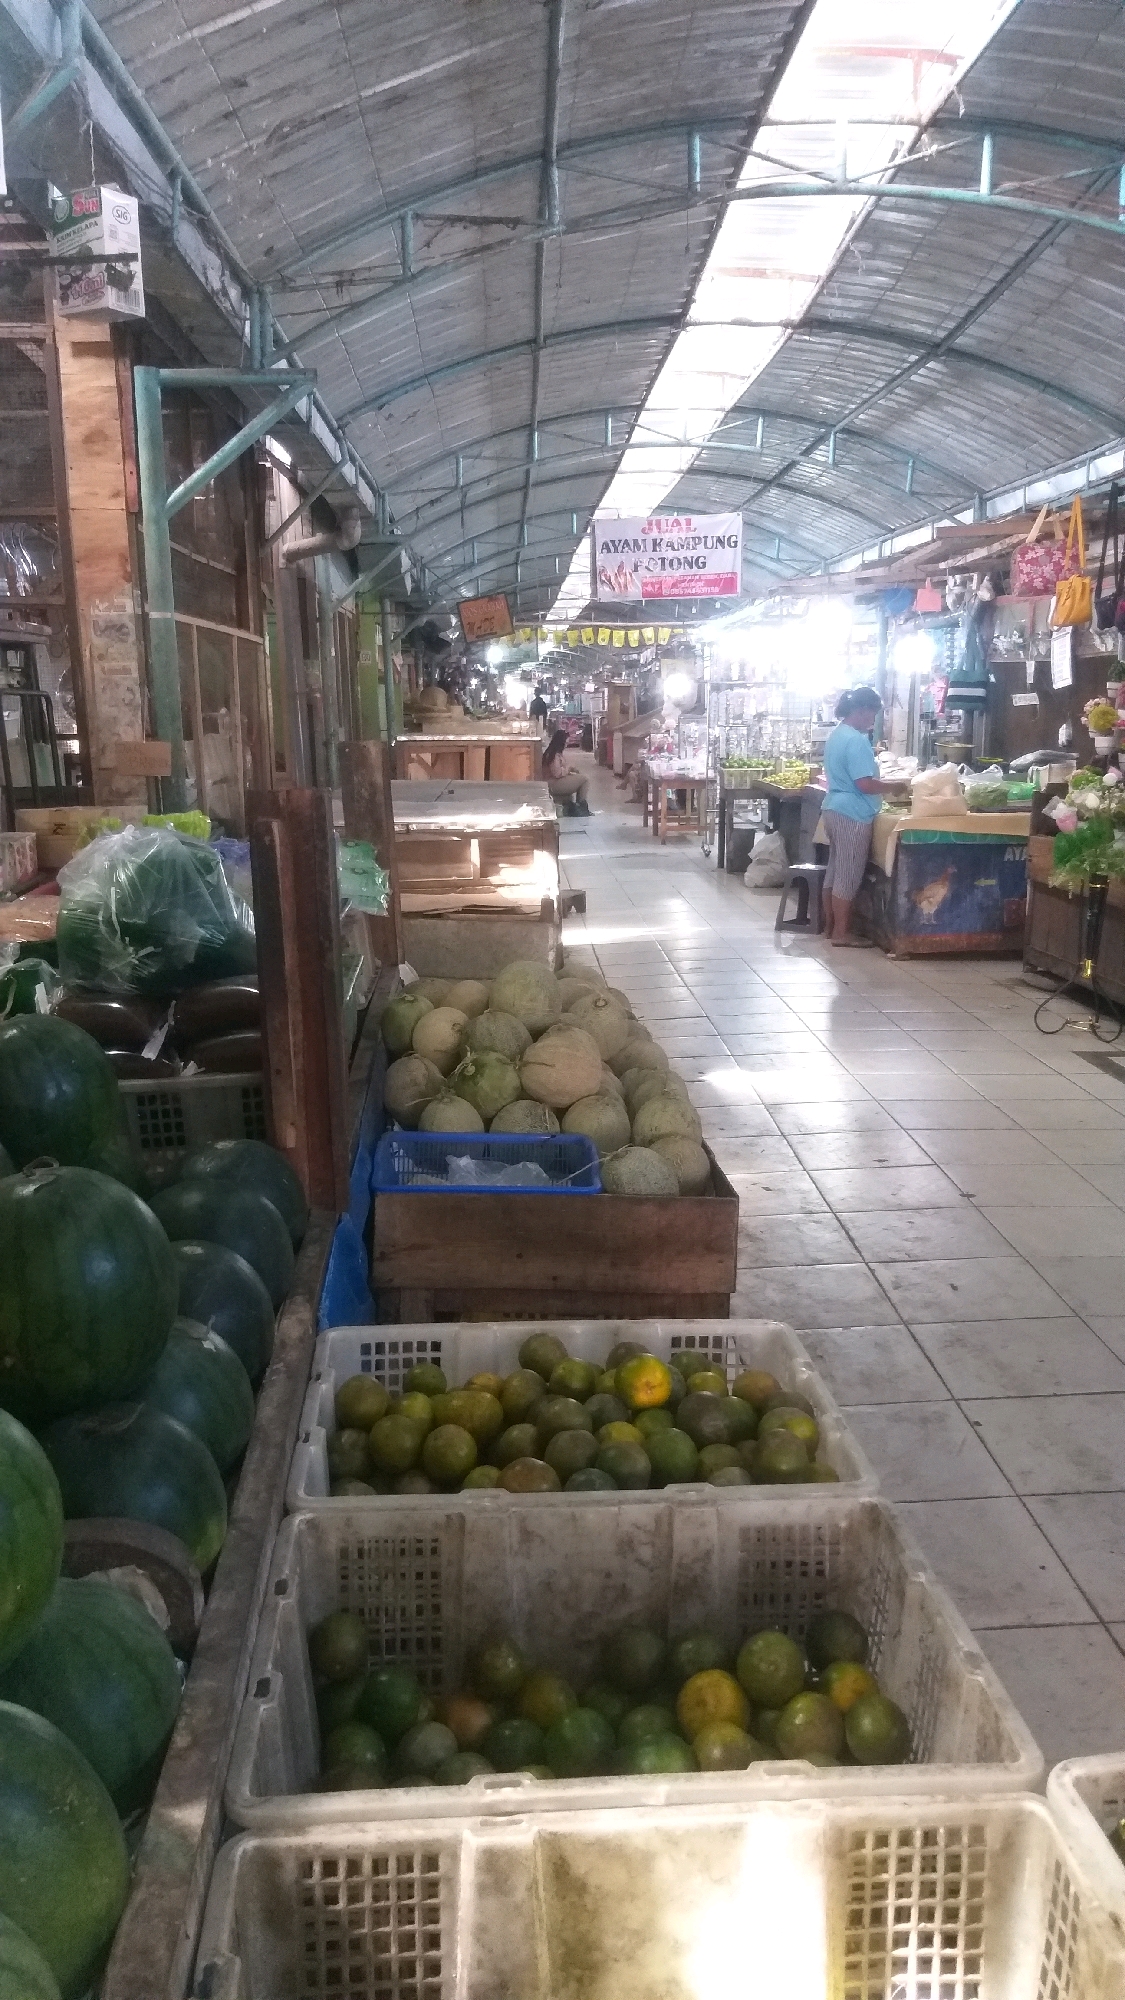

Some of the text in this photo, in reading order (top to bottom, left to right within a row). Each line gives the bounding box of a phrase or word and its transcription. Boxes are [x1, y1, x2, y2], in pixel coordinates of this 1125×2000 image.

[115, 210, 129, 220] SIG
[641, 518, 698, 535] JUAL
[600, 535, 739, 554] AYAM KAMPUNG
